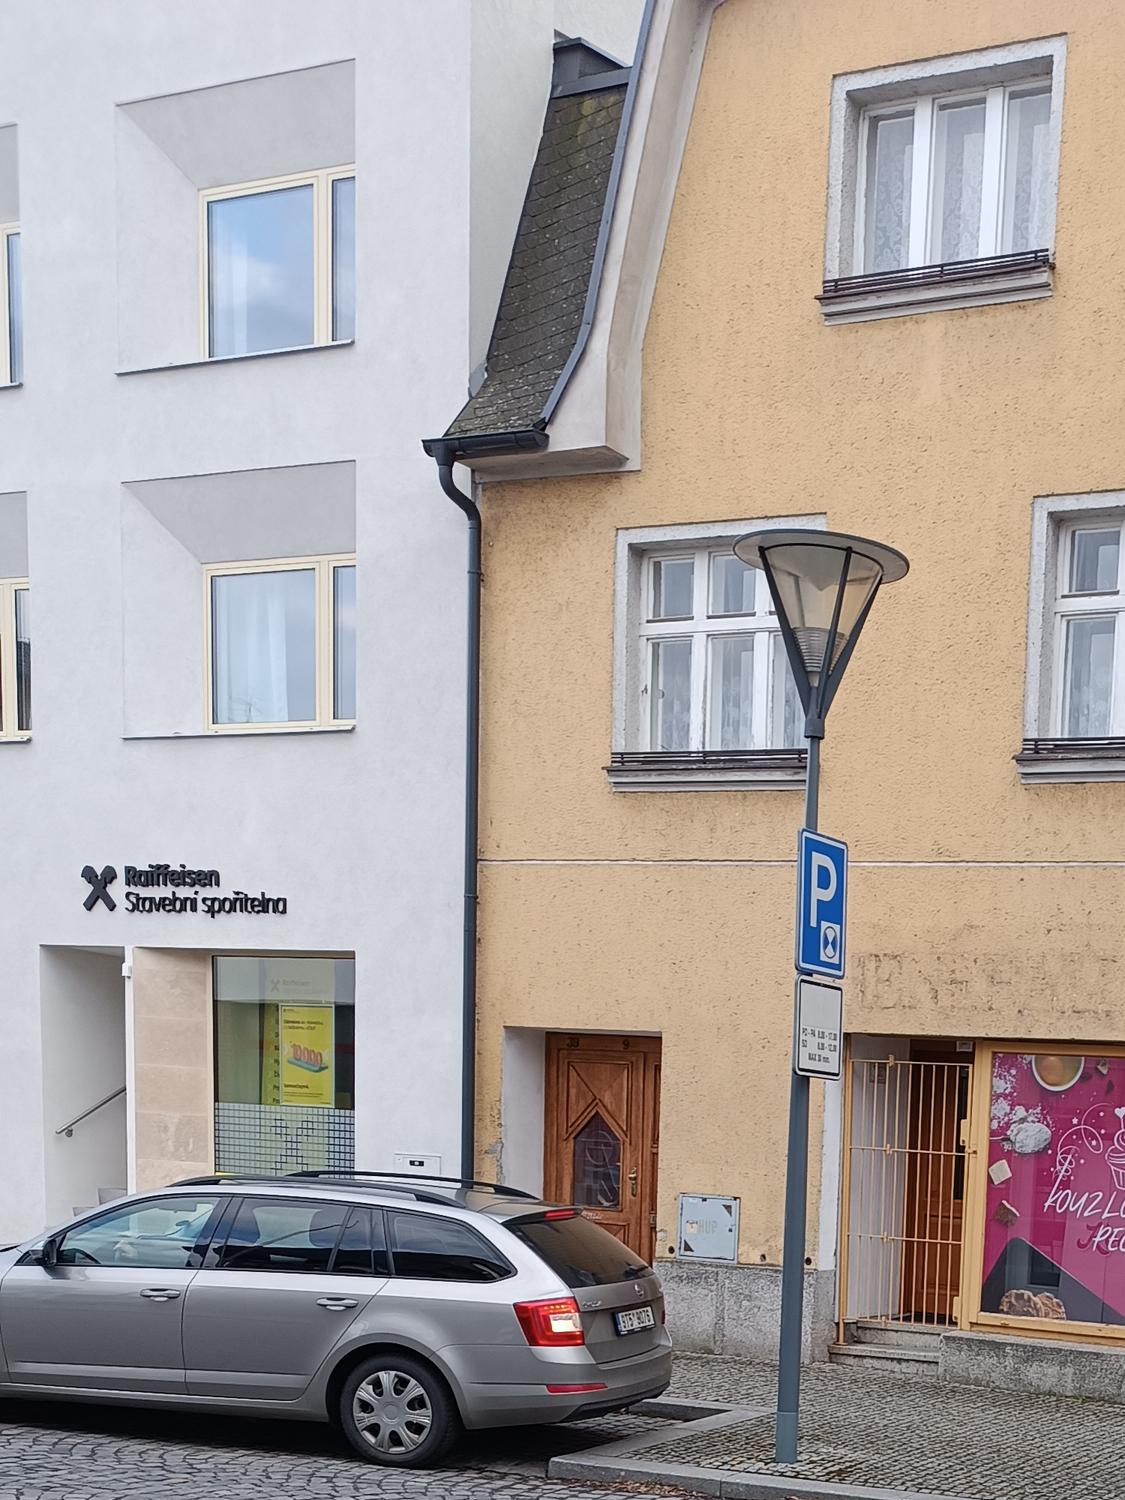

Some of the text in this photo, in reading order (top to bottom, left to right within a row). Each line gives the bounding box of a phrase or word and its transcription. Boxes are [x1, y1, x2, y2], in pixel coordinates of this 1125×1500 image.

[124, 864, 220, 888] Raiffeisen
[810, 851, 837, 928] P
[124, 890, 288, 918] Stavební spořitelna
